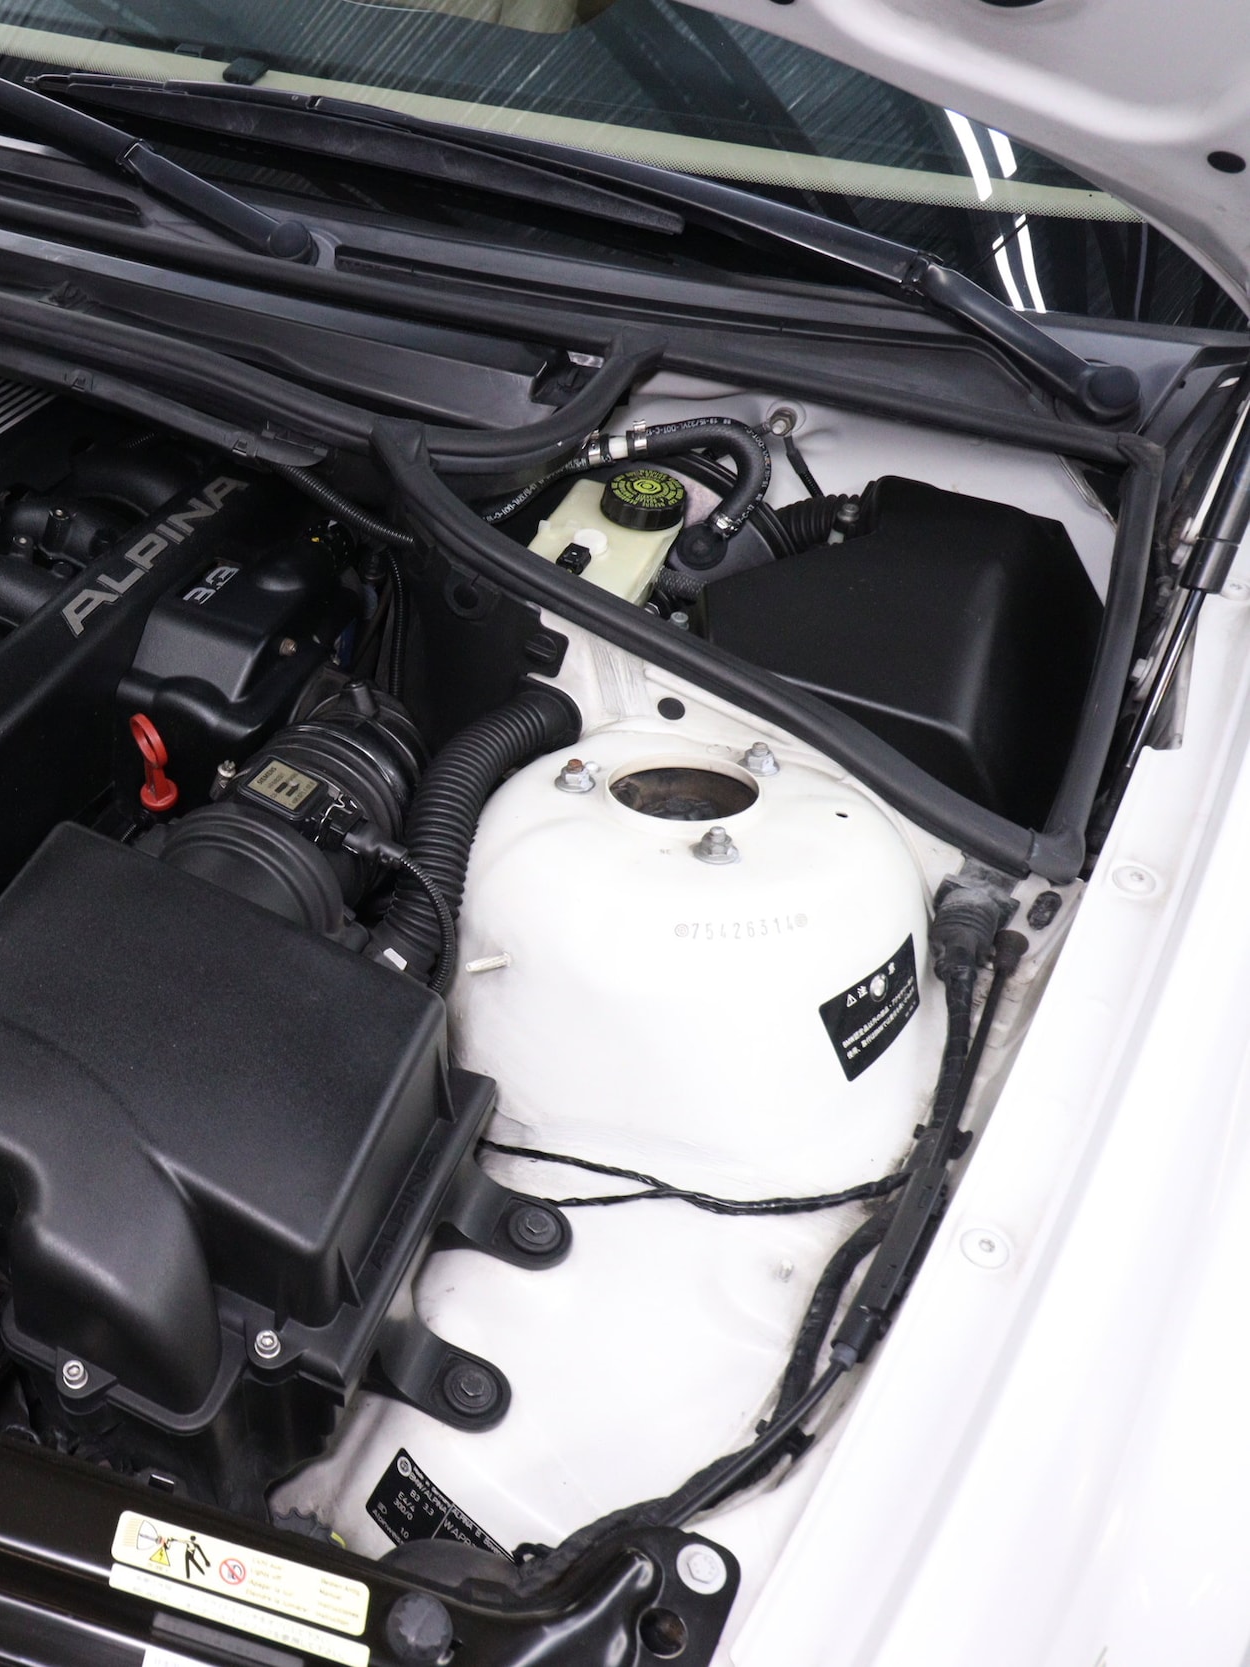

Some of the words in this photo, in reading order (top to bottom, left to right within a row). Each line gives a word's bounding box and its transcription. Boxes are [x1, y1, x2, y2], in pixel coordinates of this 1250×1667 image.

[60, 475, 250, 638] ALPINA
[182, 565, 242, 606] 3.3
[408, 1472, 448, 1514] BMW/ALPINA
[410, 1488, 421, 1502] B3
[422, 1502, 435, 1516] 3.3
